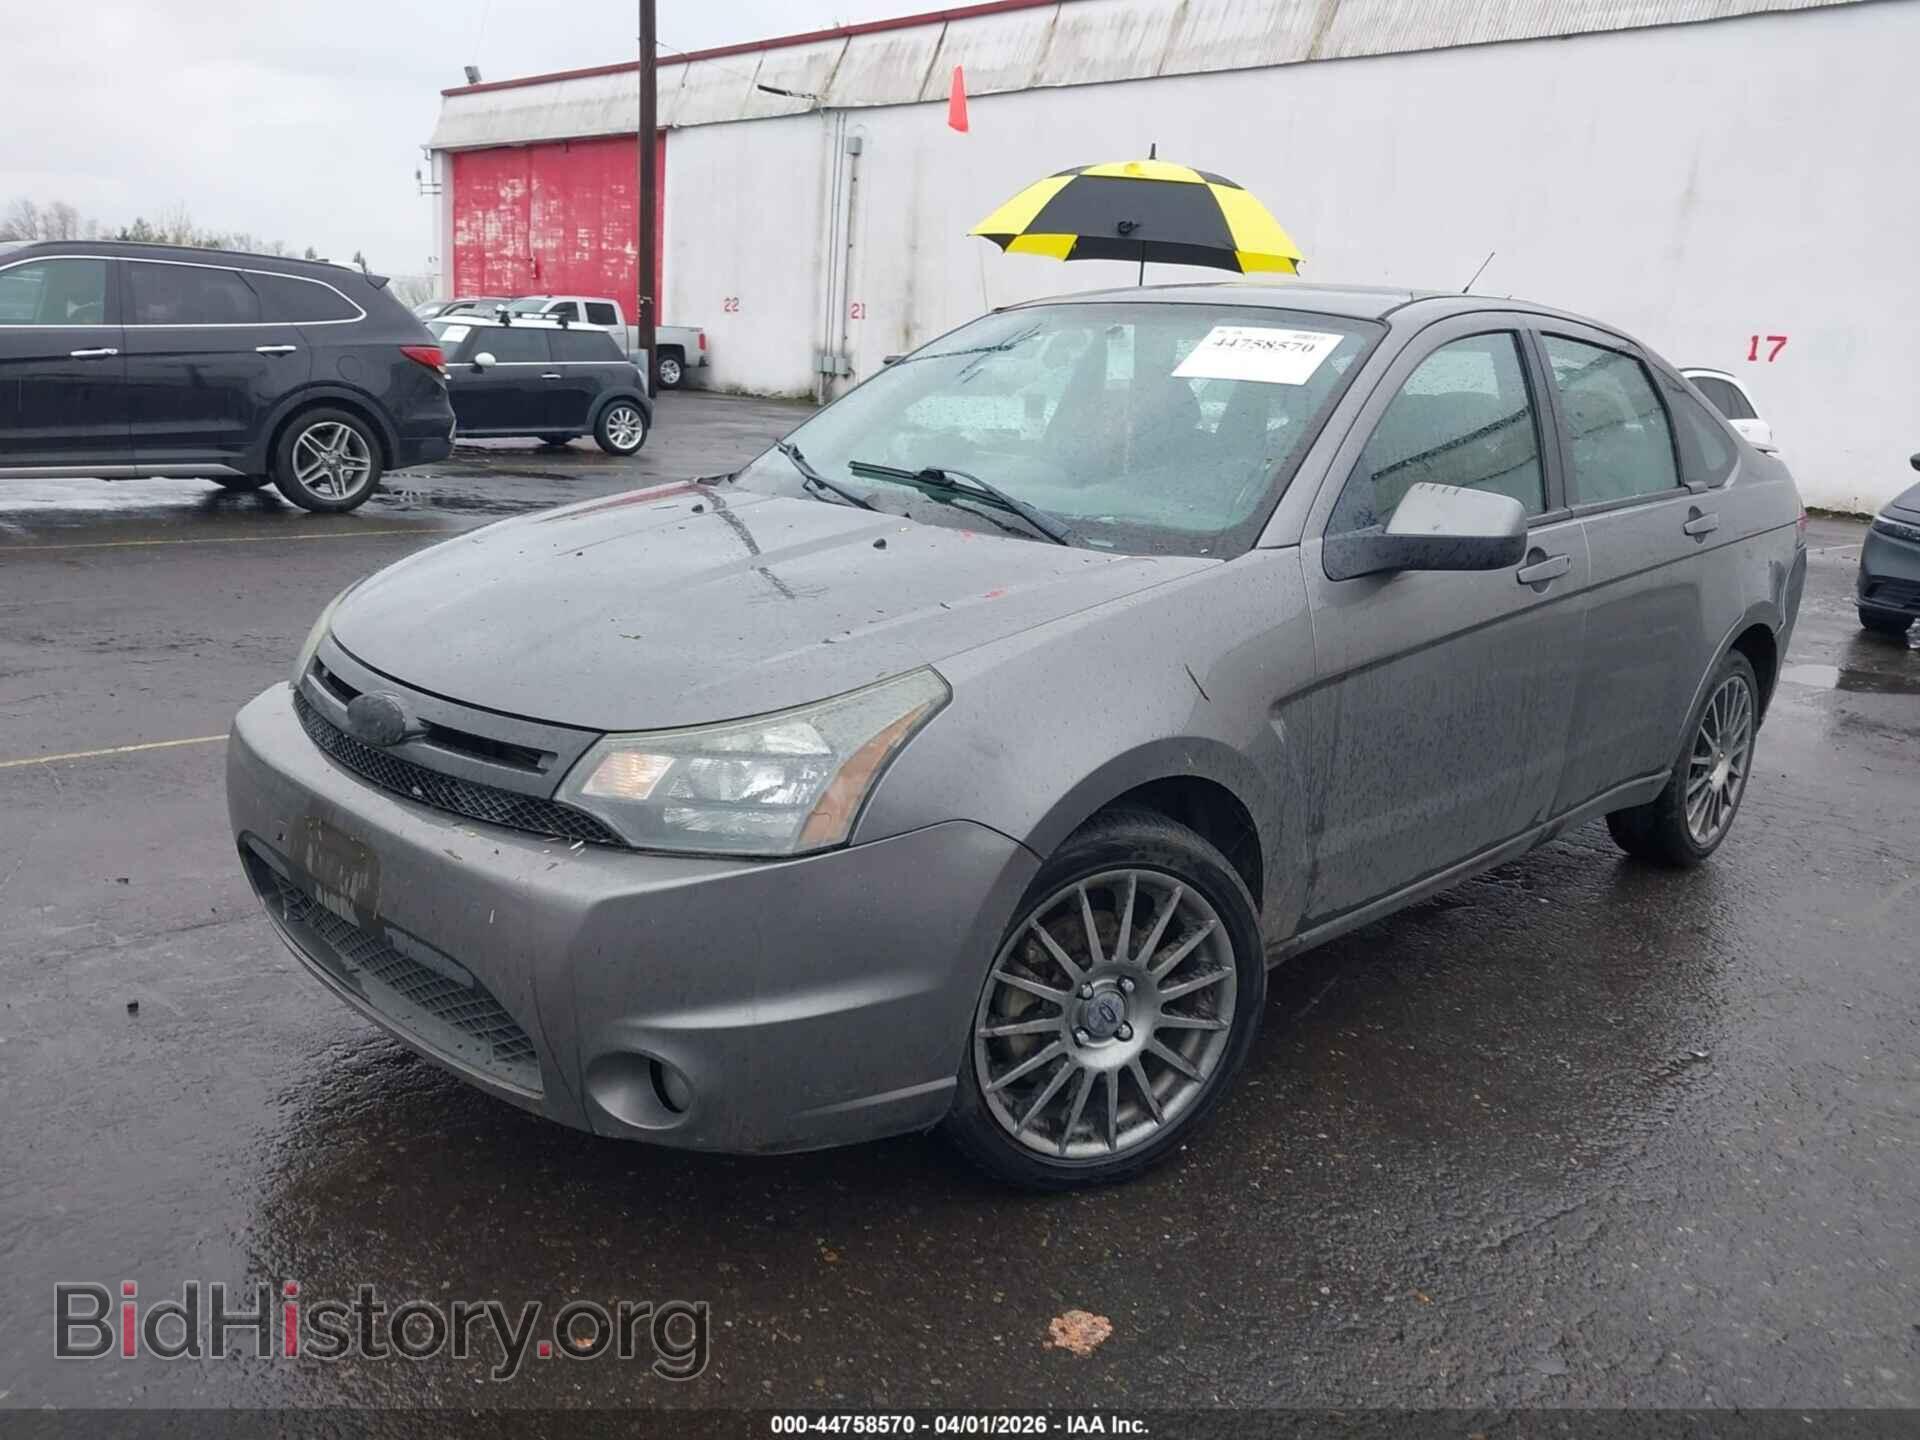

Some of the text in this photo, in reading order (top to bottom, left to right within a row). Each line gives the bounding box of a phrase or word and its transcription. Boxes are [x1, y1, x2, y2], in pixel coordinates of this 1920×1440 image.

[724, 296, 739, 312] 22
[851, 303, 866, 320] 21
[1747, 335, 1788, 362] 17
